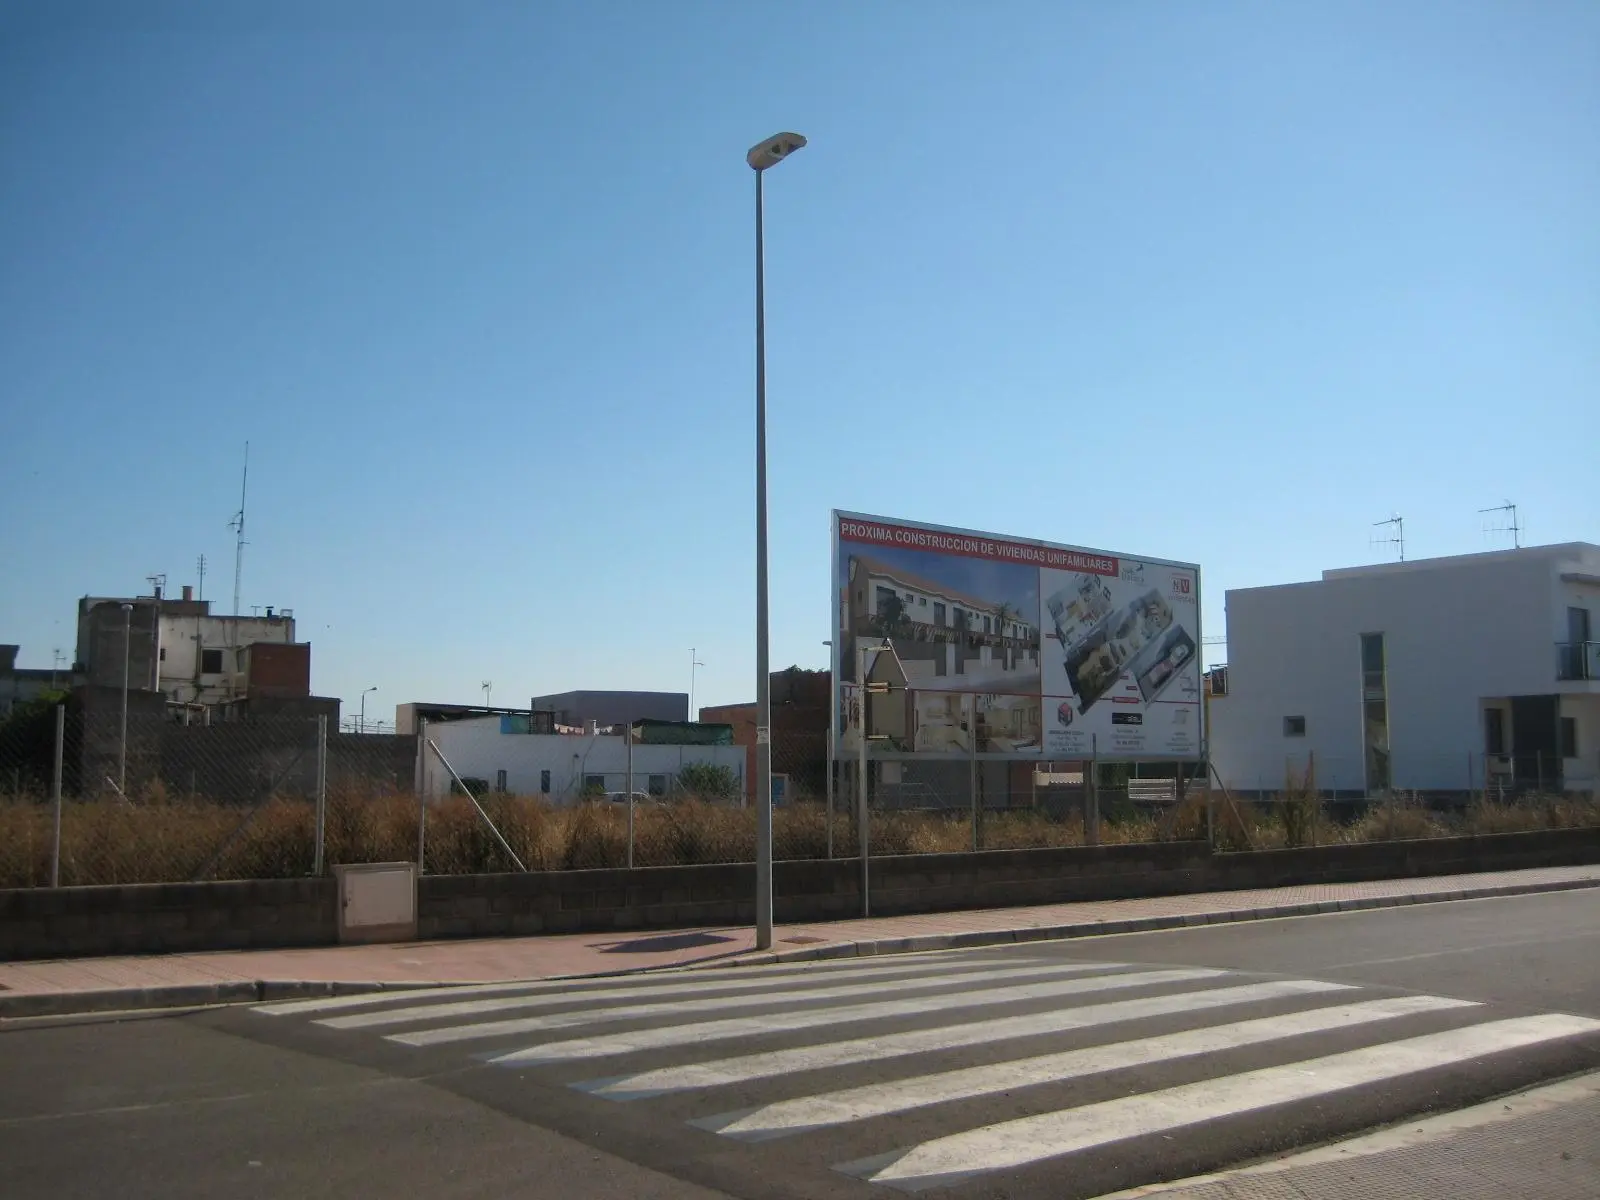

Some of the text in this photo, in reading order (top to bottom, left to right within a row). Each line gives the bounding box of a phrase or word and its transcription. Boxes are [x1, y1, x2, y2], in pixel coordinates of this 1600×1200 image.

[841, 522, 1113, 571] PROXIMA CONSTRUCCION DE VIVIENDAS UNIFAMILIARES
